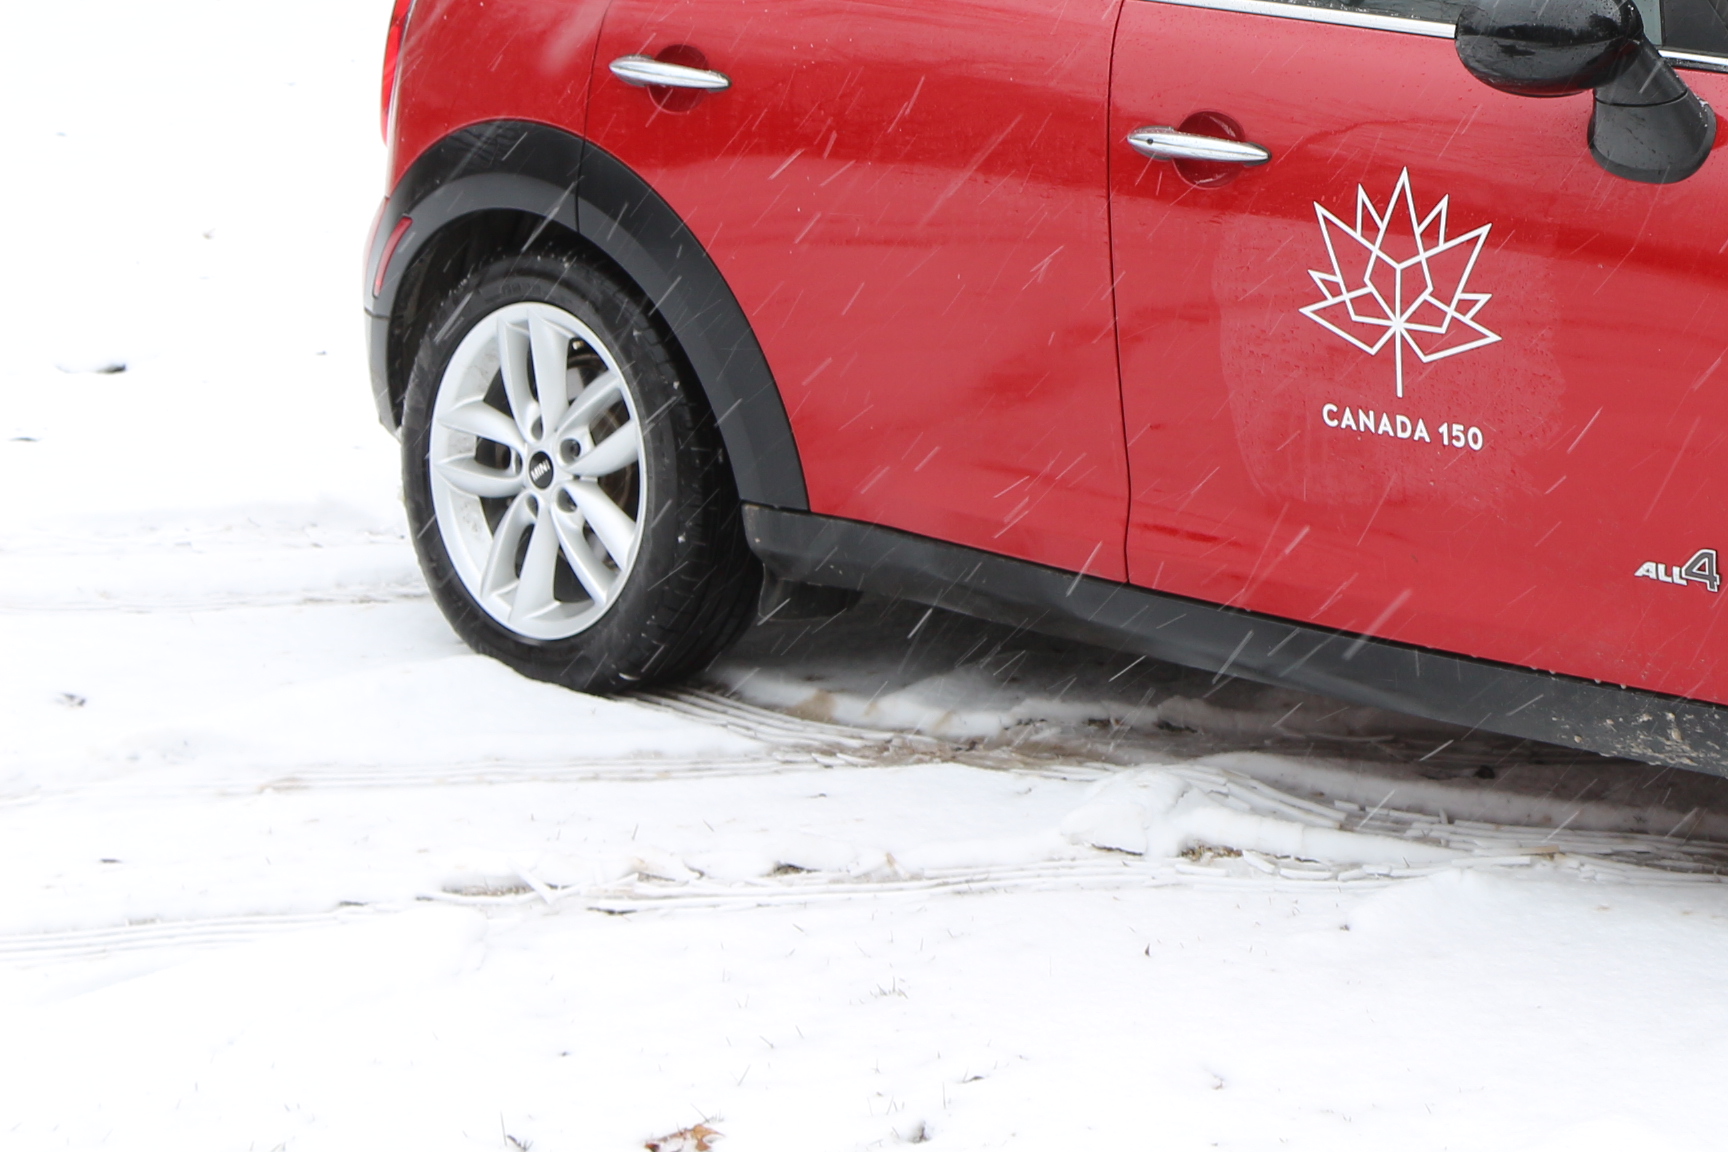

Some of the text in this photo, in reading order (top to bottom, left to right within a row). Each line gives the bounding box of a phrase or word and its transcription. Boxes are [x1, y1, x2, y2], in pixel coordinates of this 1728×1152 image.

[1321, 403, 1483, 451] CANADA 150
[530, 459, 551, 481] MINI
[1634, 548, 1720, 593] ALL4
